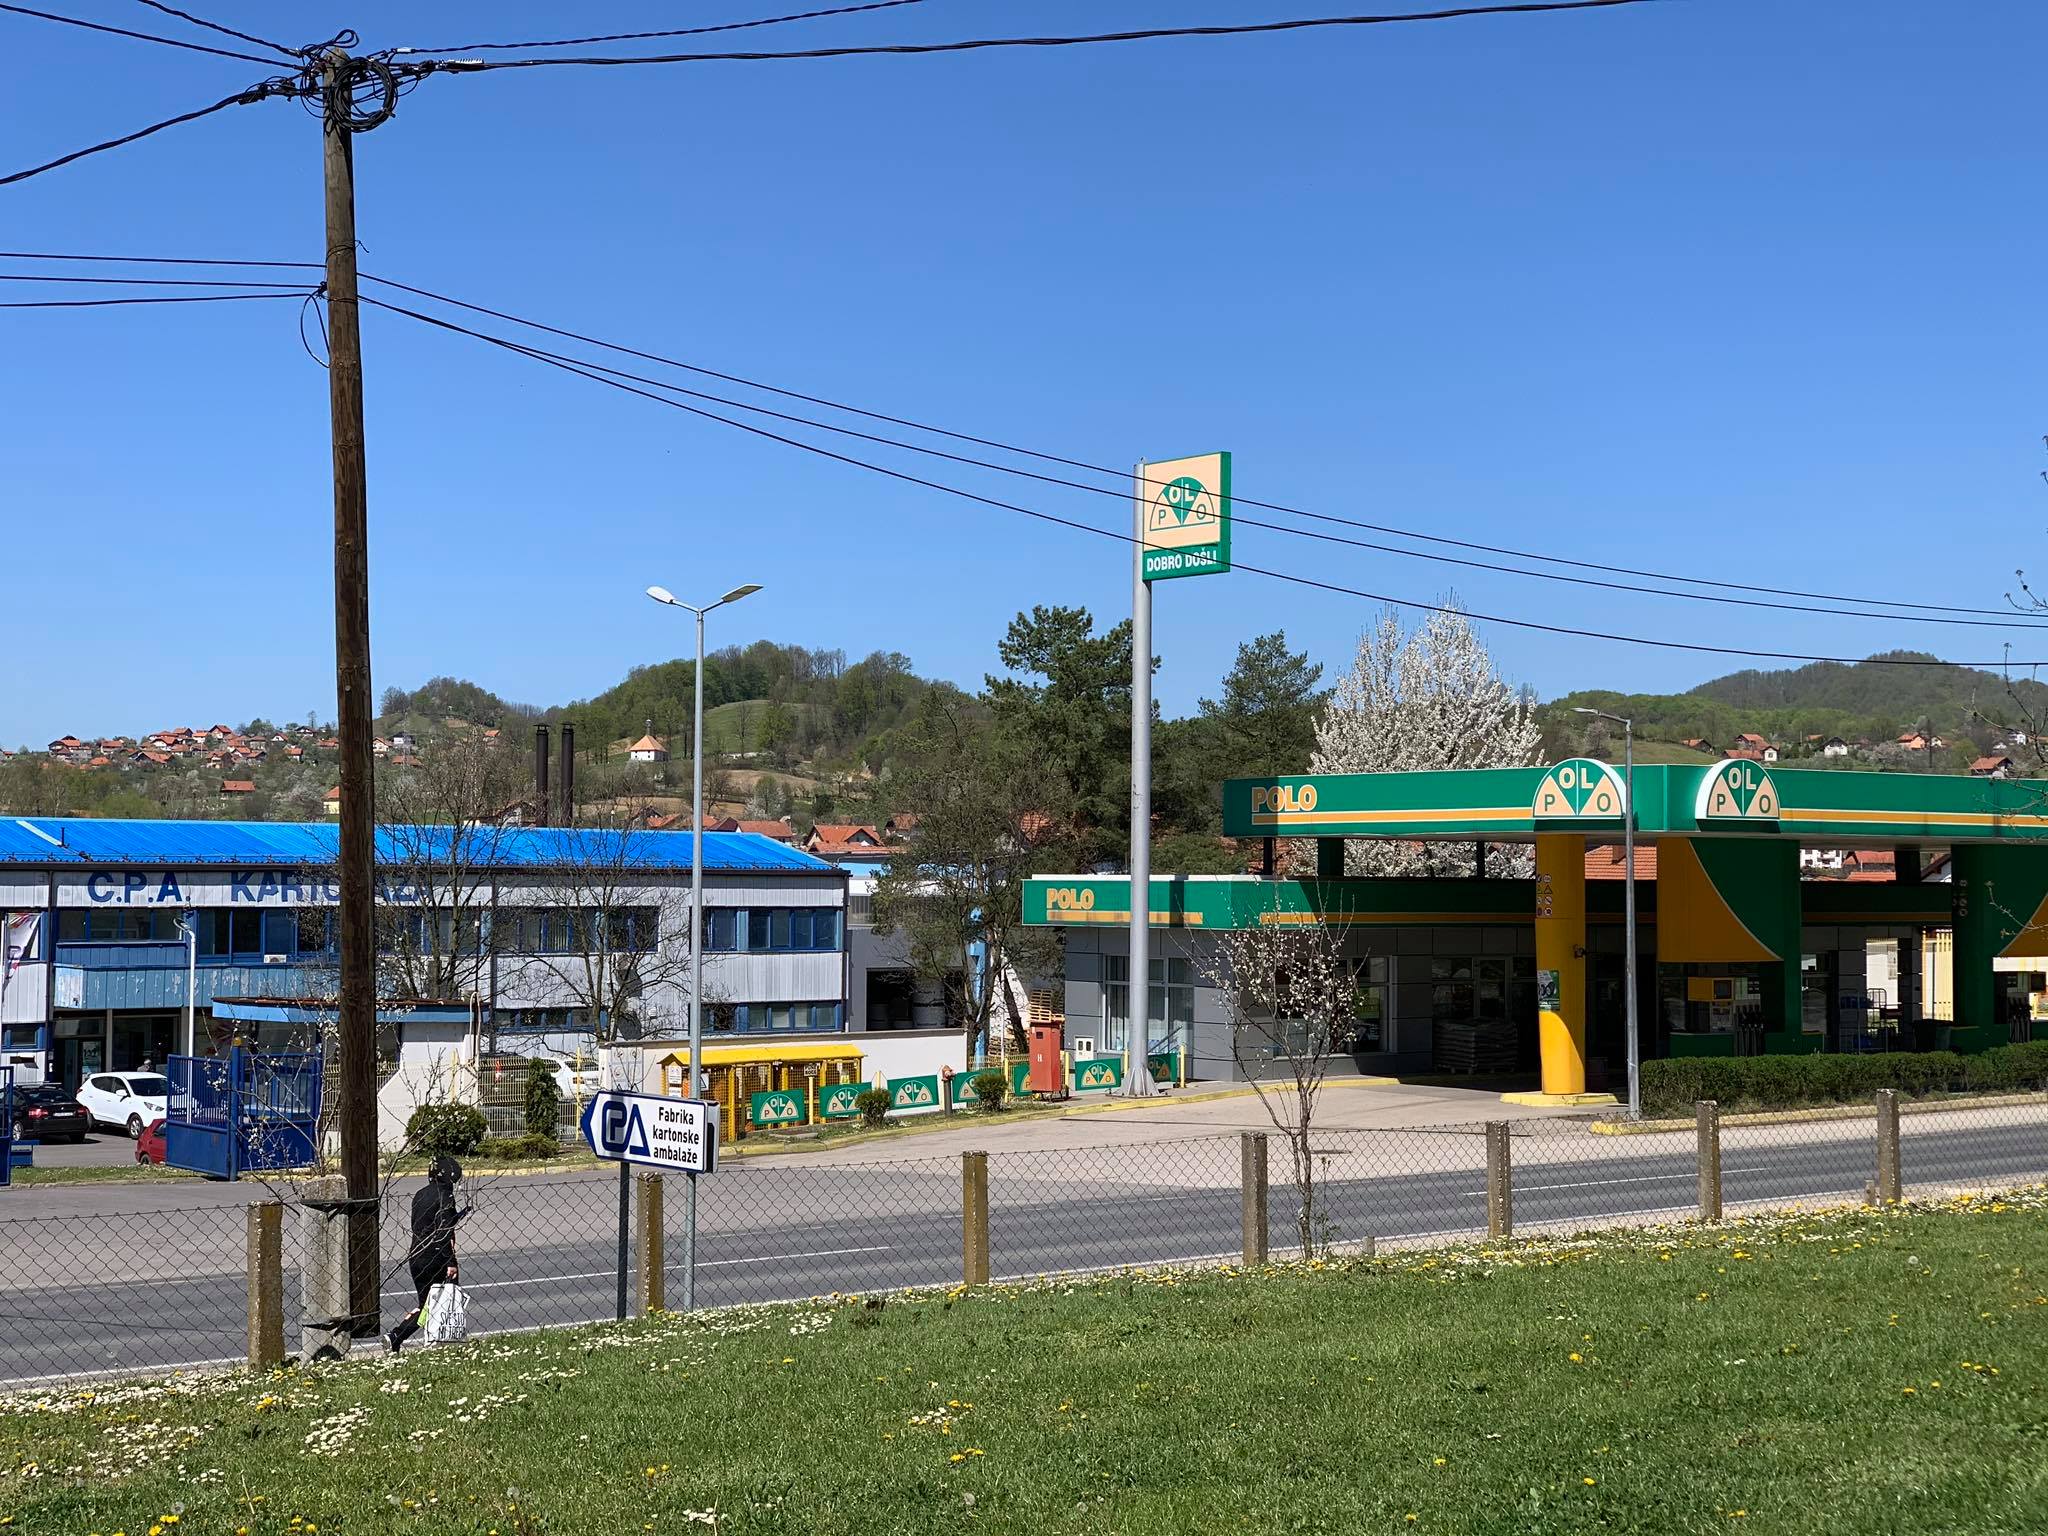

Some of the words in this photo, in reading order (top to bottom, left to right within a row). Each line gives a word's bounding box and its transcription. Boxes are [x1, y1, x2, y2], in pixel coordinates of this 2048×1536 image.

[1146, 553, 1182, 572] DOBRO
[1185, 547, 1217, 568] DOŠLI
[1251, 784, 1318, 812] POLO
[87, 870, 191, 903] C.P.A.
[1046, 887, 1095, 910] POLO
[658, 1106, 694, 1125] Fabrika
[652, 1125, 700, 1145] kartonske
[653, 1145, 698, 1163] ambalaže
